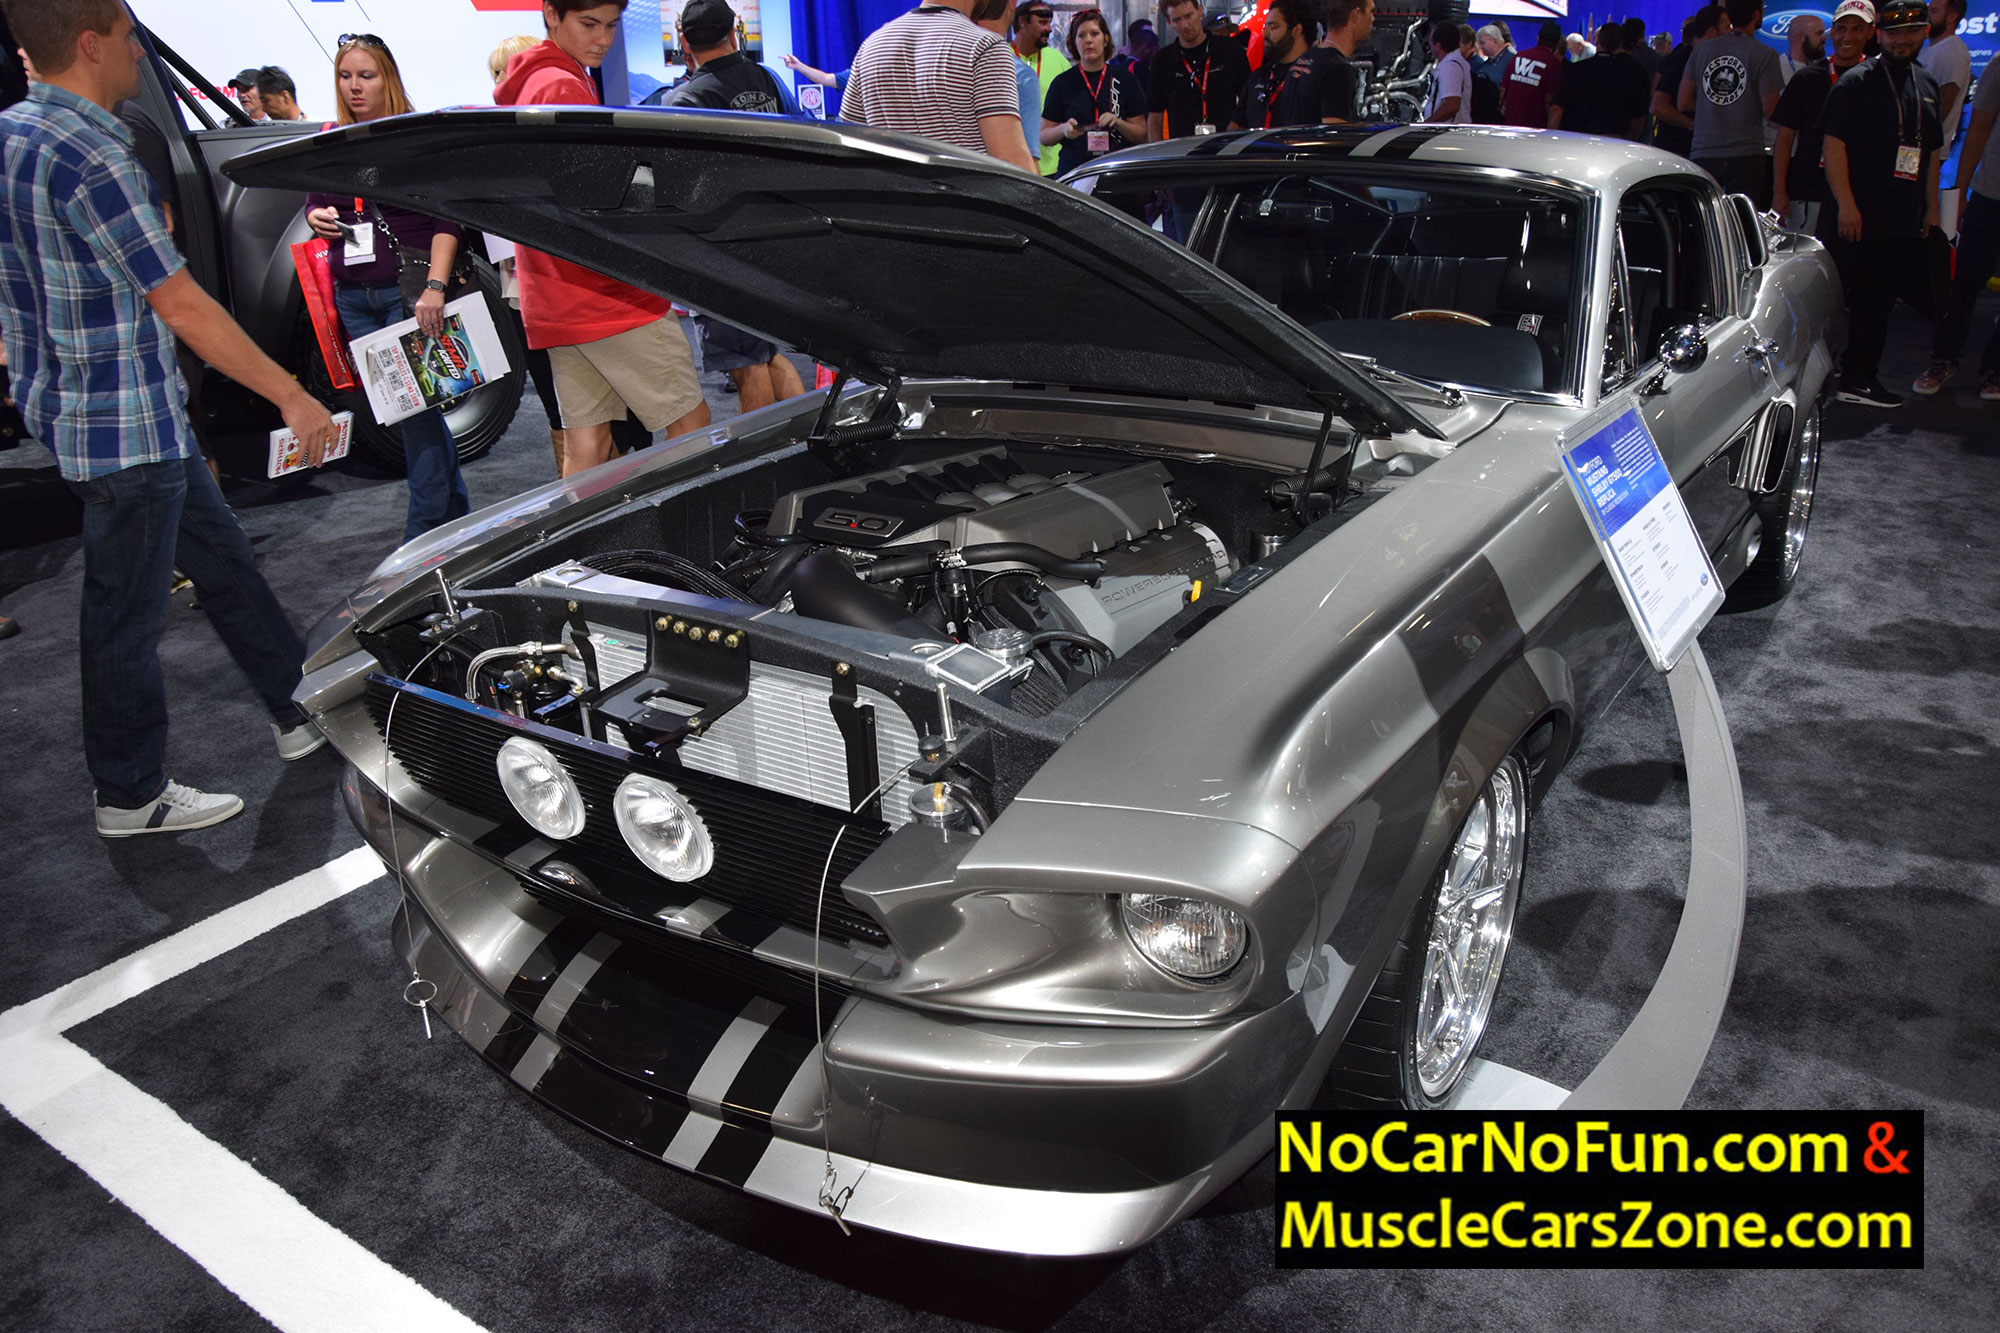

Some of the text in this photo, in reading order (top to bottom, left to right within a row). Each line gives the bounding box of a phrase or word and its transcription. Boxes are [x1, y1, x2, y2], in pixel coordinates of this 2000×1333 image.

[1703, 57, 1745, 82] RESTORED
[1705, 83, 1744, 104] DETROIT
[437, 349, 461, 380] IGNITED
[1585, 463, 1609, 487] MUSTANG
[825, 512, 892, 531] 5.0
